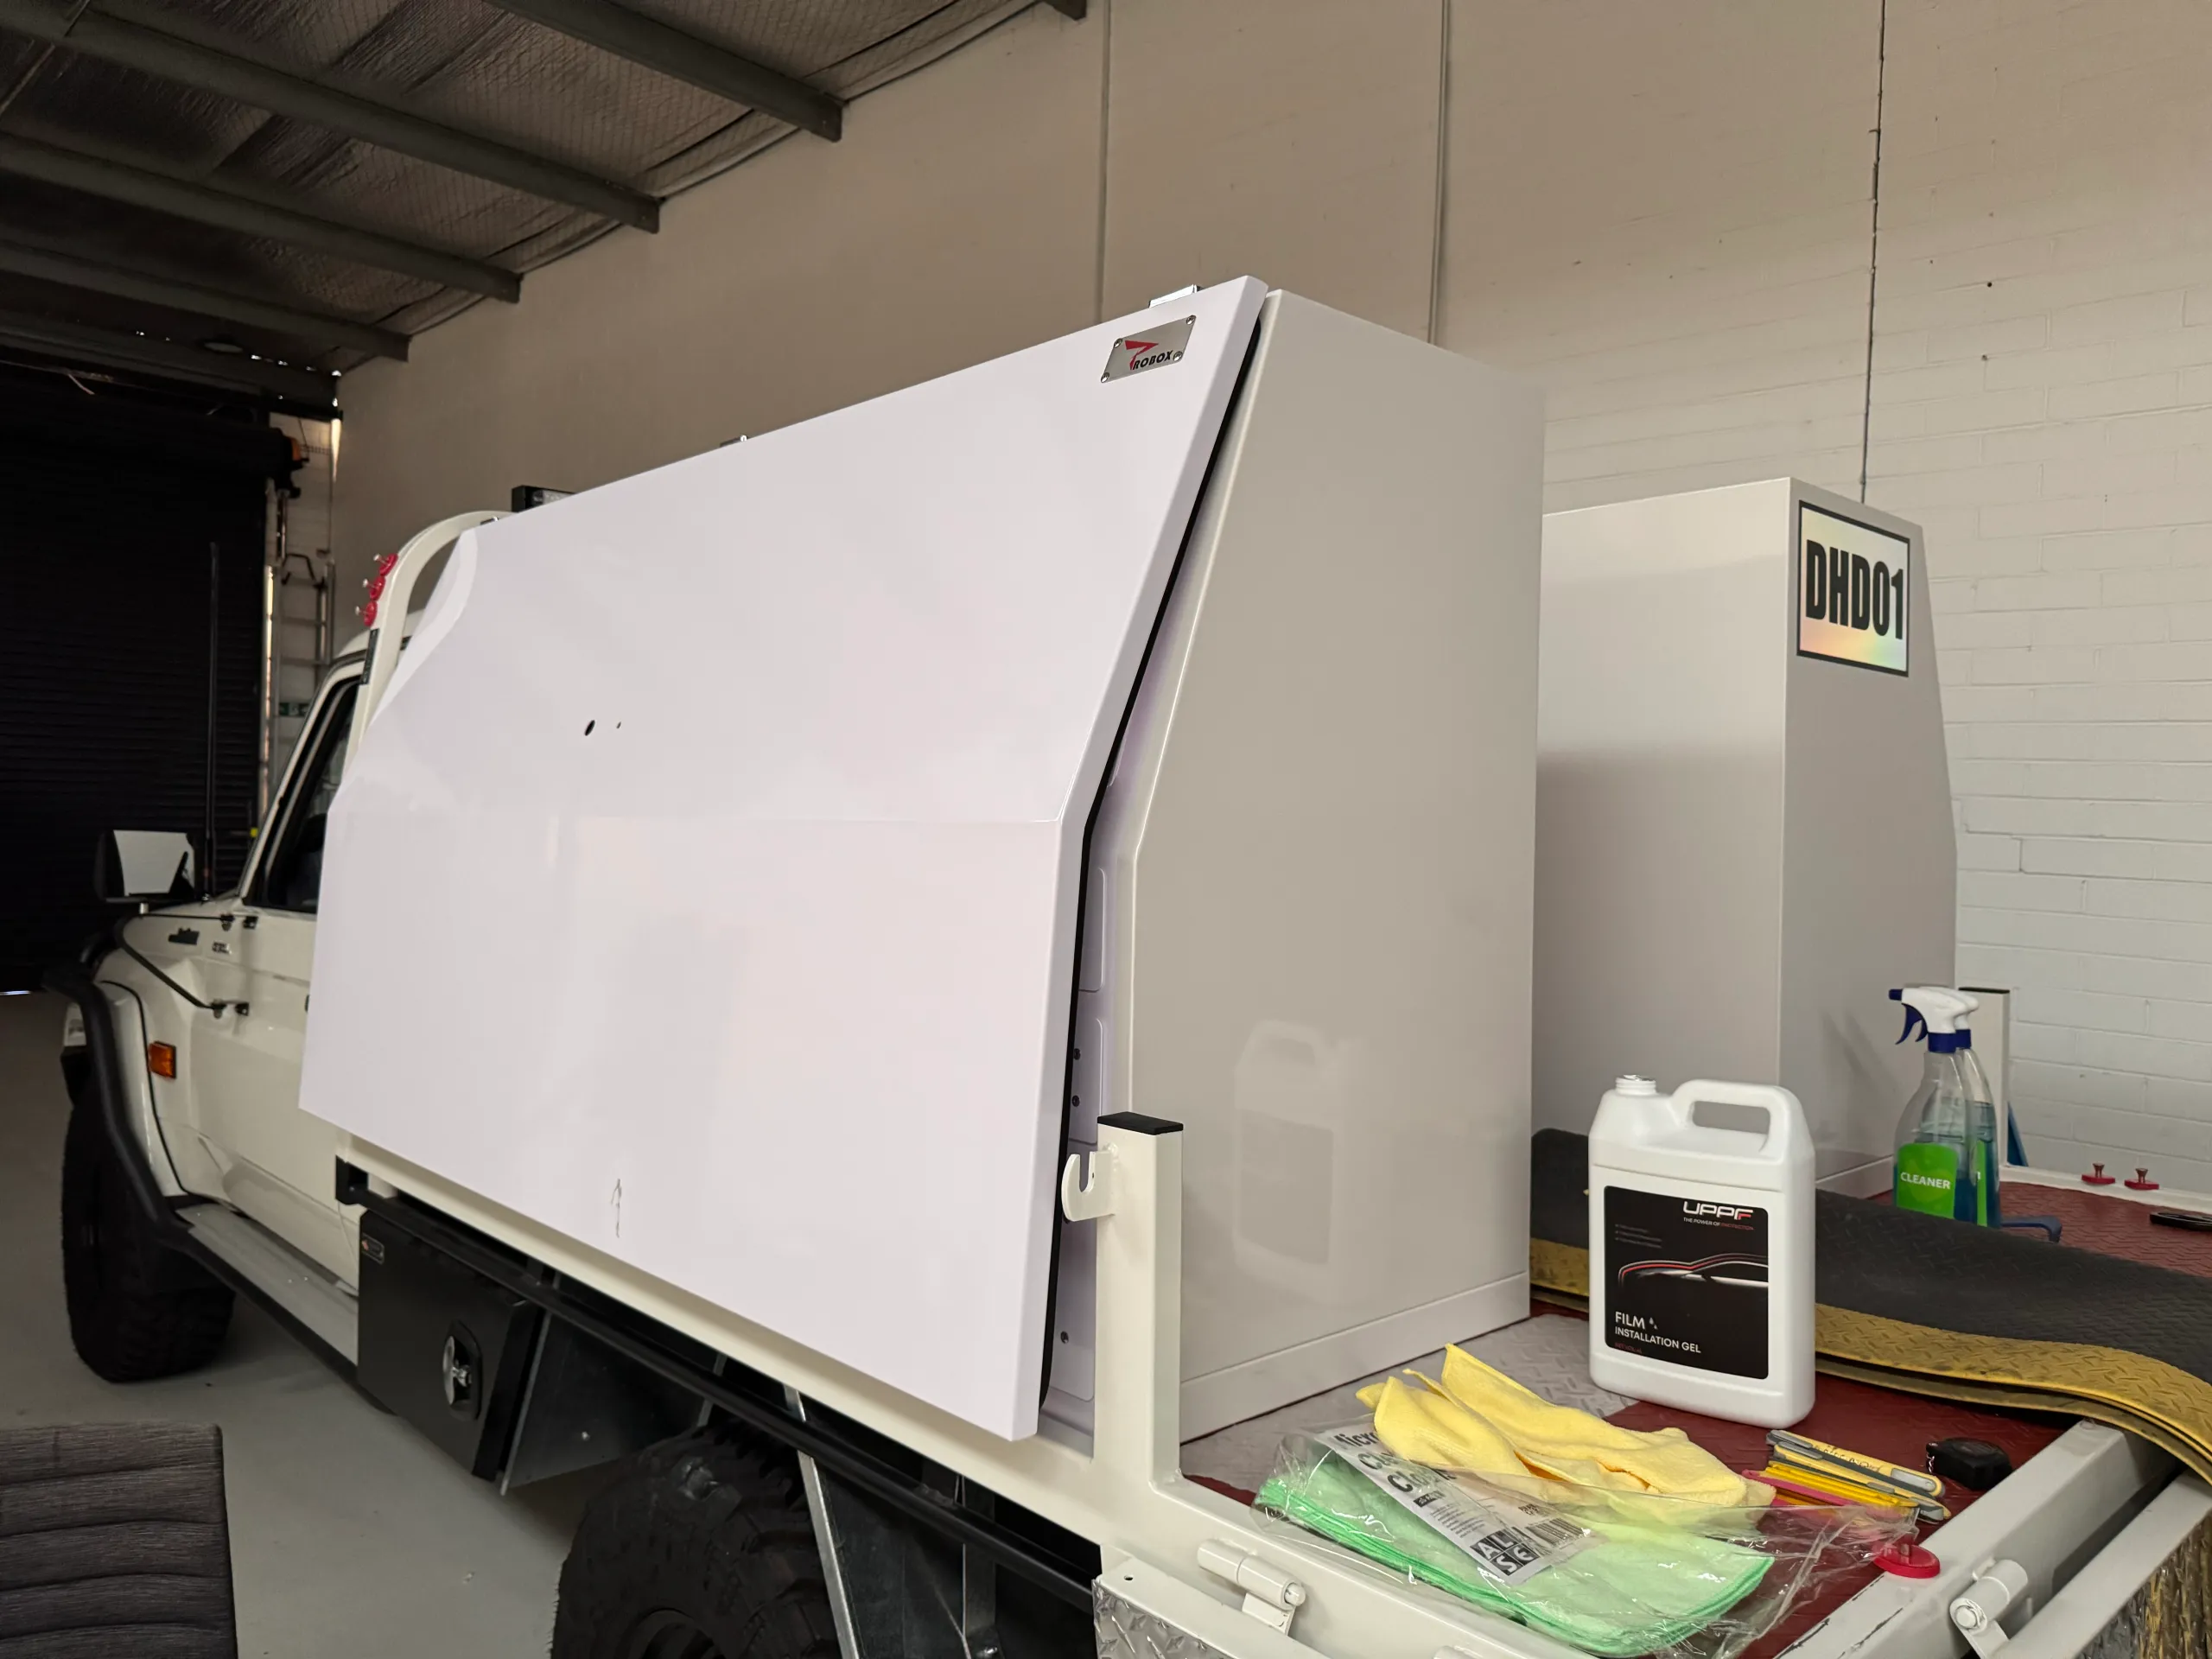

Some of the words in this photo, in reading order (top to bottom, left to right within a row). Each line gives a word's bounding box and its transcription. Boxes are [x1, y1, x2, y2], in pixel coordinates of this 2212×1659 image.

[1806, 538, 1904, 640] DHD01
[1900, 1172, 1951, 1190] CLEANER
[1682, 1200, 1754, 1221] UPPF
[1615, 1311, 1646, 1330] FILM
[1614, 1325, 1680, 1349] INSTALLATION
[1681, 1341, 1701, 1354] GEL
